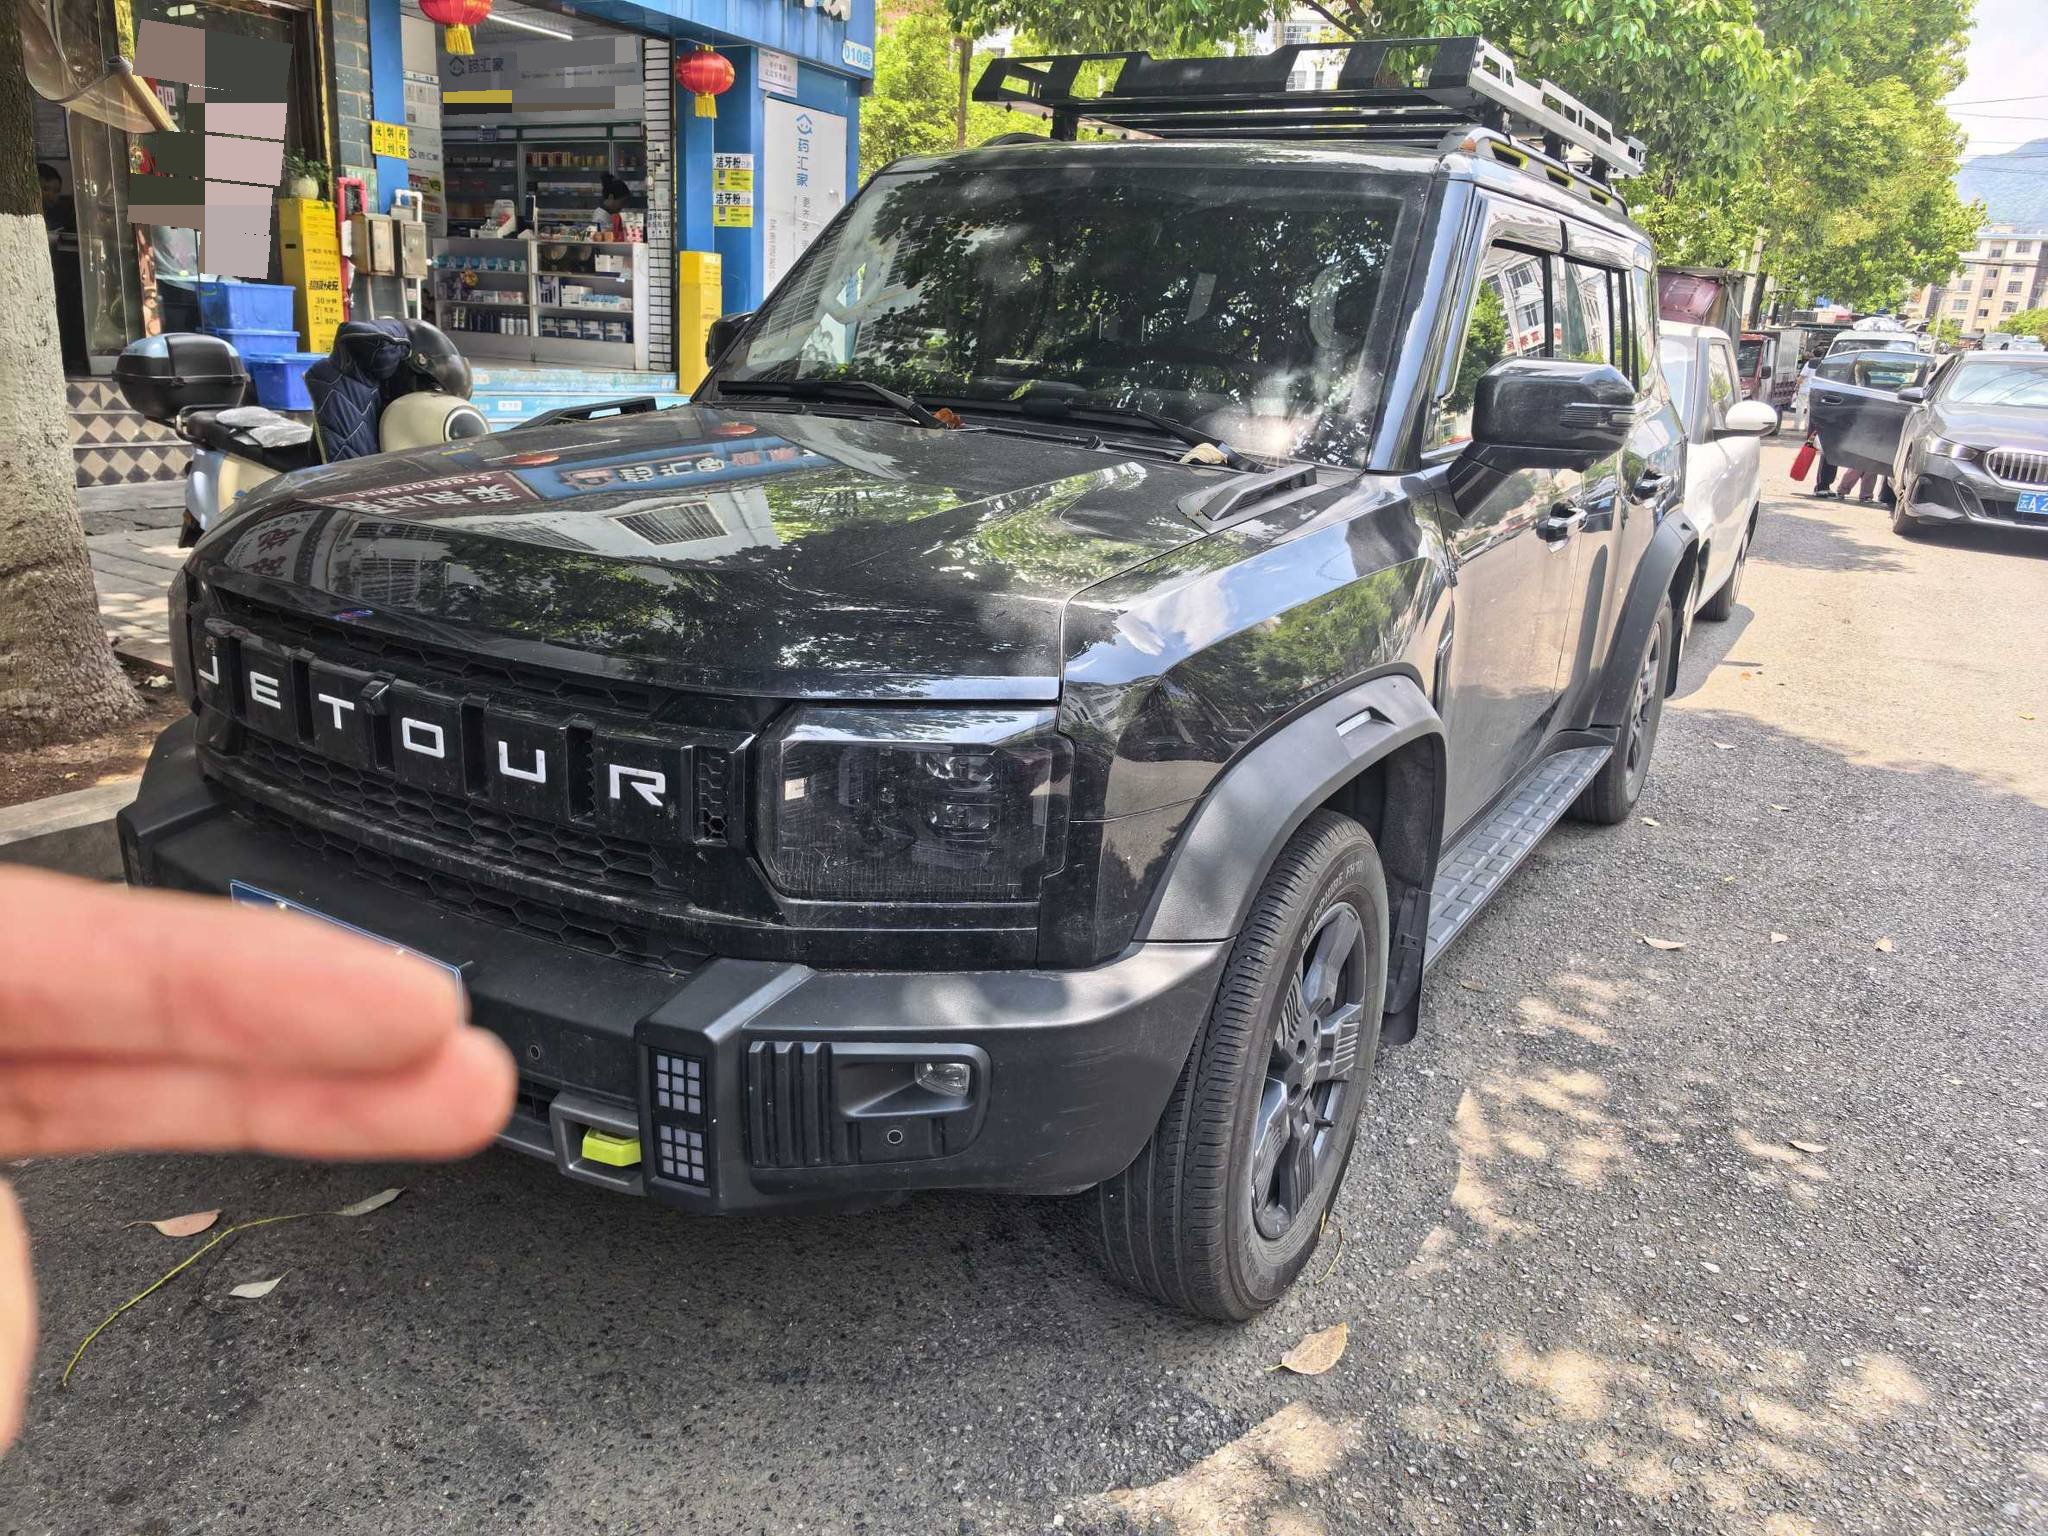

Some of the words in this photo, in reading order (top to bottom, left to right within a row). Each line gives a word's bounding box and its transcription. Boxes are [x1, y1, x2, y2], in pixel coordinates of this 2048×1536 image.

[844, 45, 872, 68] 010店
[715, 156, 741, 169] 洁牙粉
[715, 193, 741, 205] 洁牙粉
[198, 655, 667, 807] JETOUR
